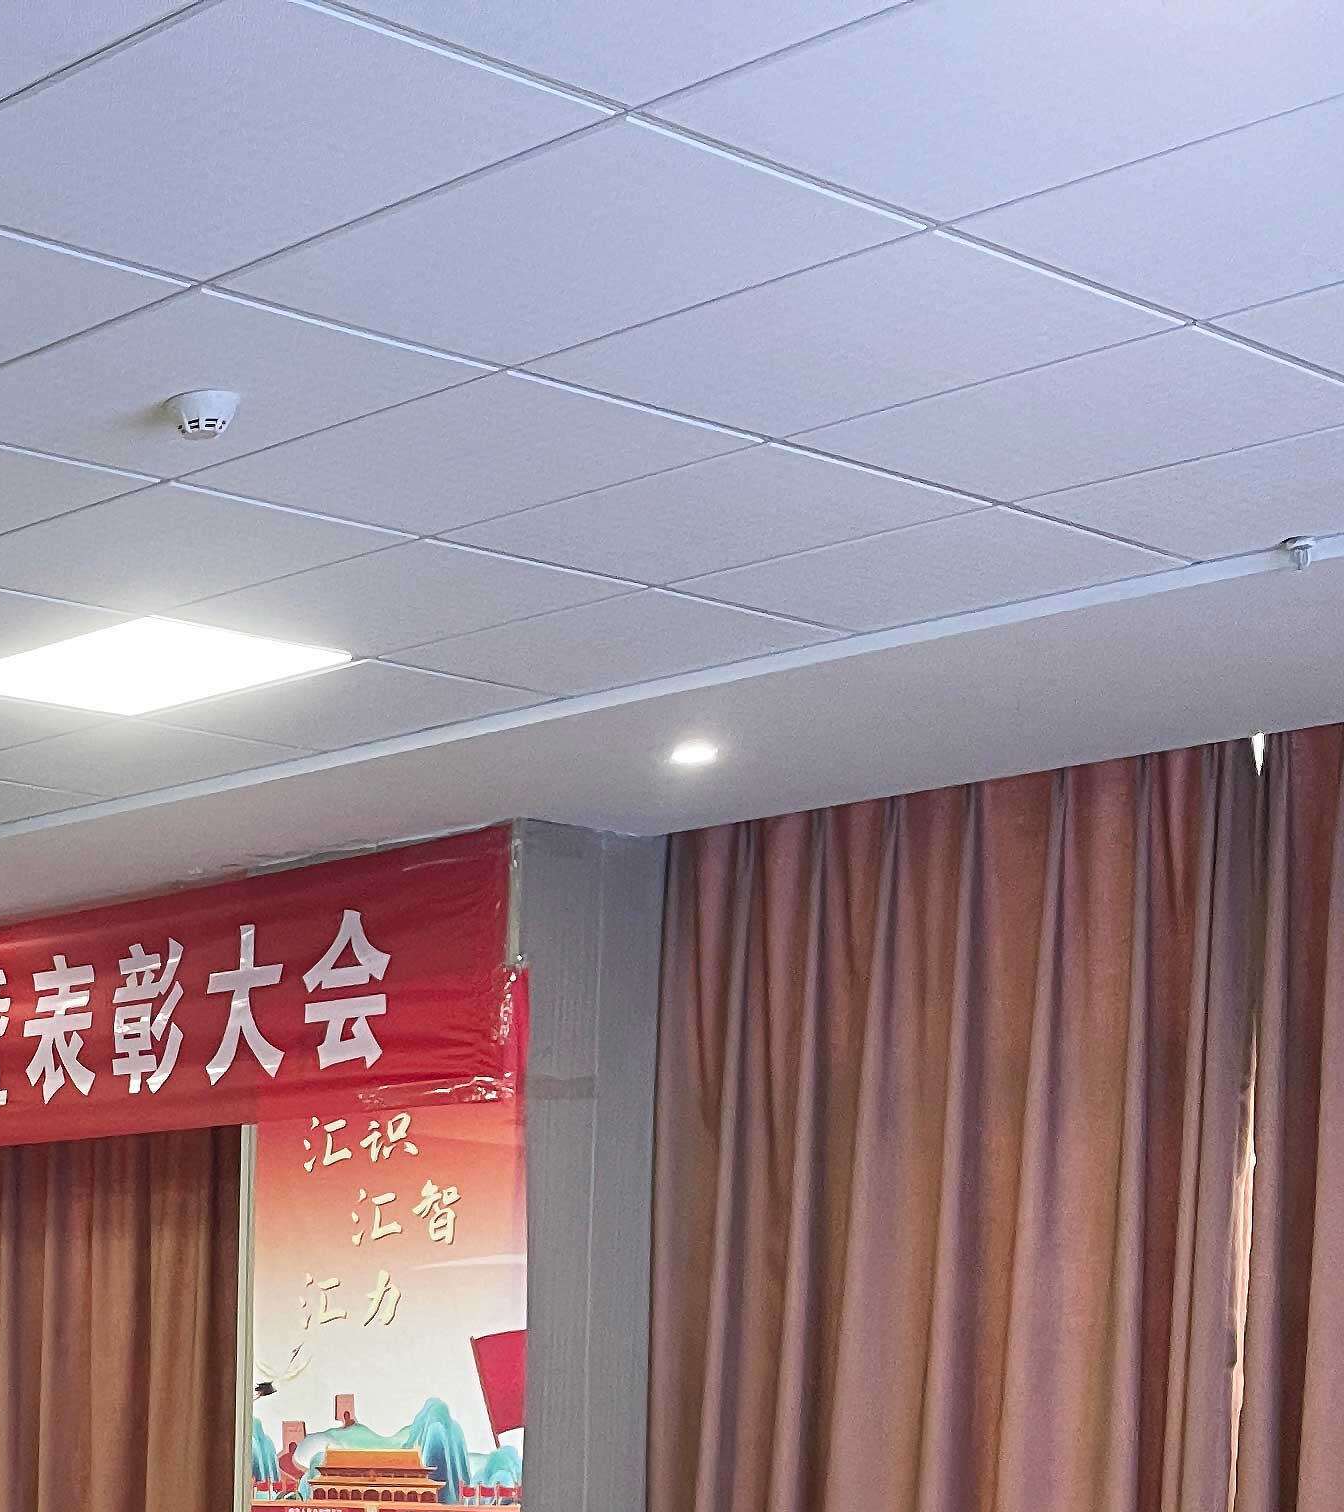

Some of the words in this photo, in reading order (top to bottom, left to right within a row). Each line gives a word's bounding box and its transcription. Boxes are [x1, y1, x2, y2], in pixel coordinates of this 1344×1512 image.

[303, 1111, 419, 1173] 汇识
[351, 1179, 461, 1246] 汇智
[298, 1269, 402, 1330] 汇力
